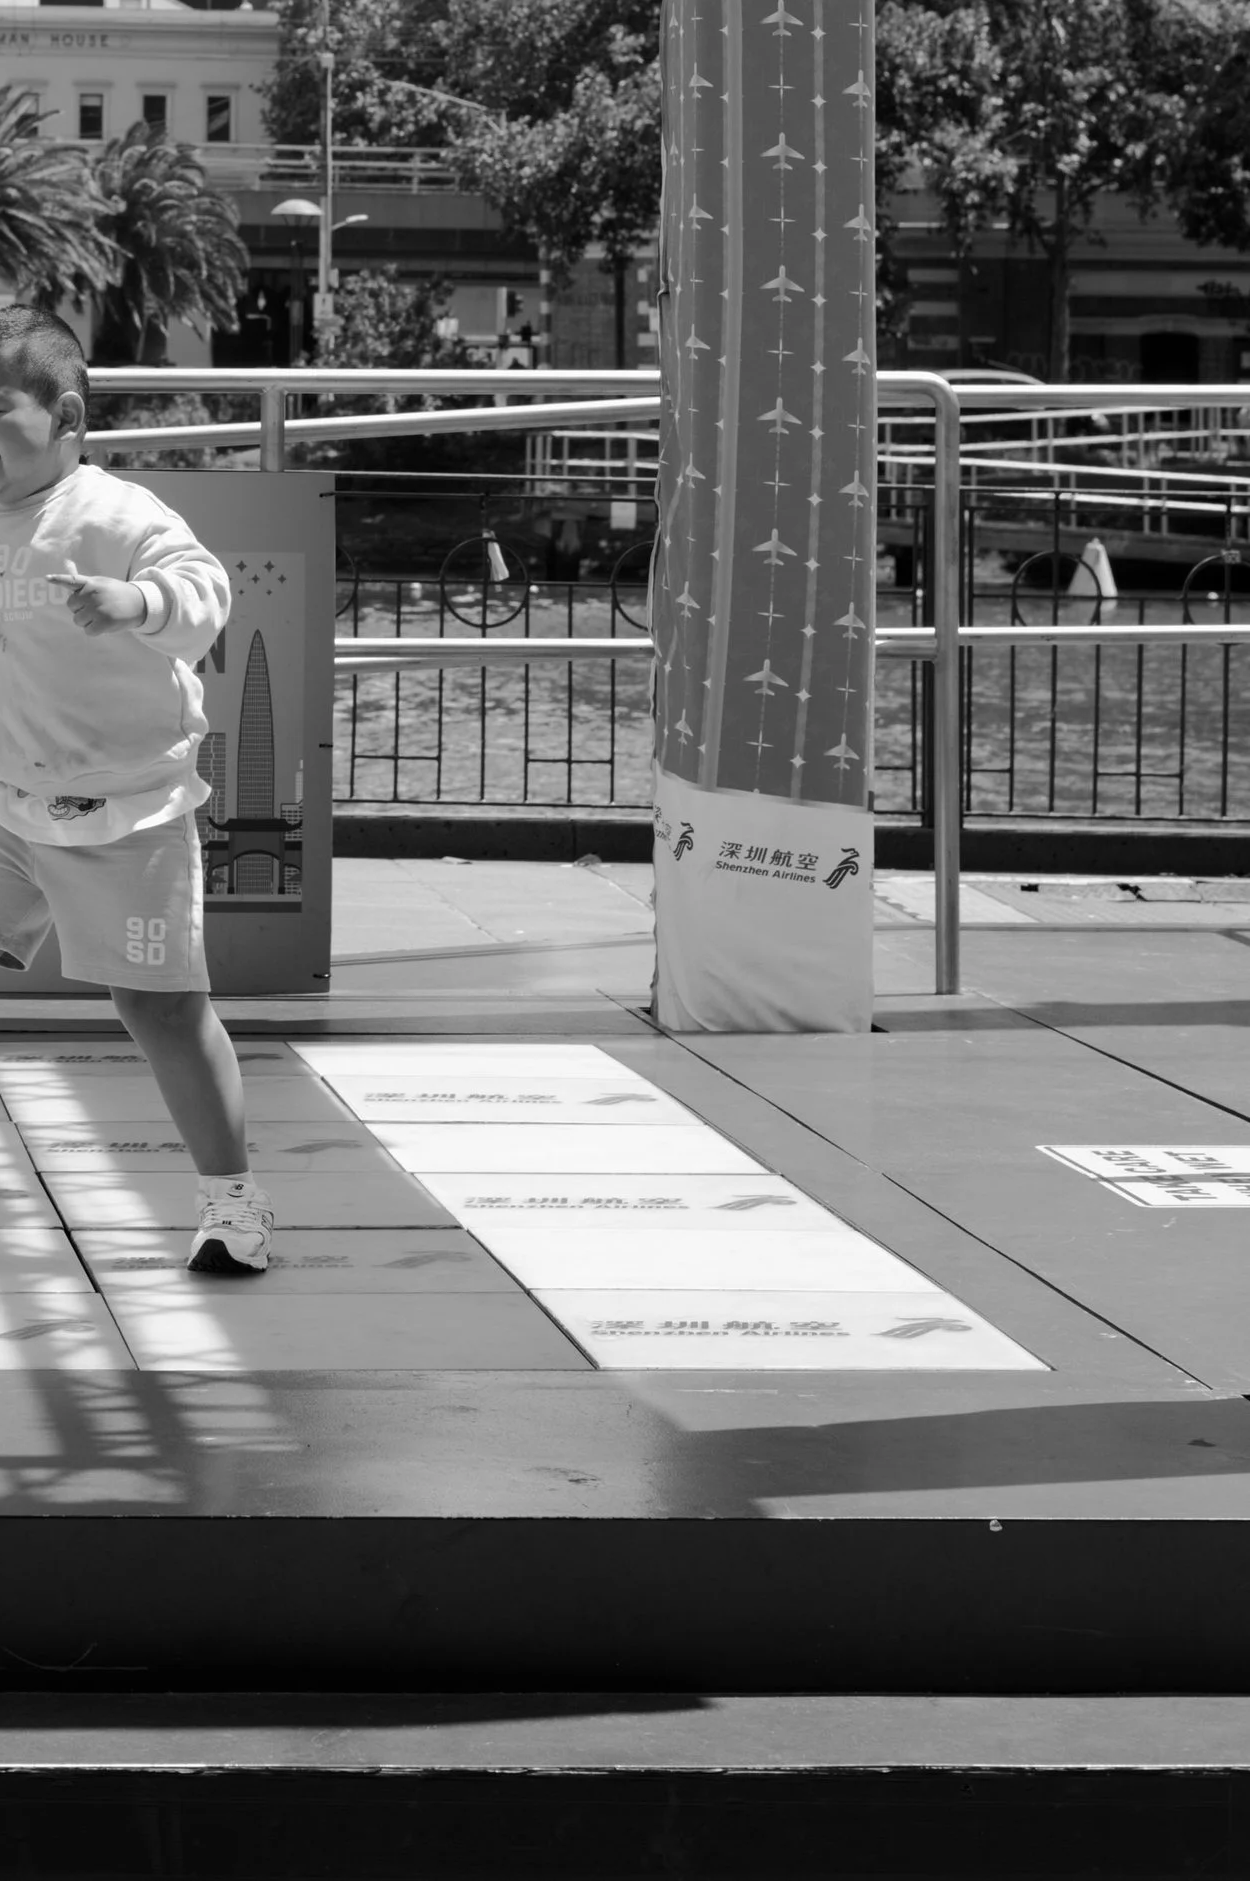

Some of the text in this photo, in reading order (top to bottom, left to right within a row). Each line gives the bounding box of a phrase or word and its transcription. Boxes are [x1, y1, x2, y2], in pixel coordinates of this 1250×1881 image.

[50, 32, 110, 48] HOUSE
[718, 840, 819, 872] 深圳航空
[715, 860, 816, 884] Shenzhen Airlines
[126, 916, 166, 941] 90
[126, 940, 166, 966] SD
